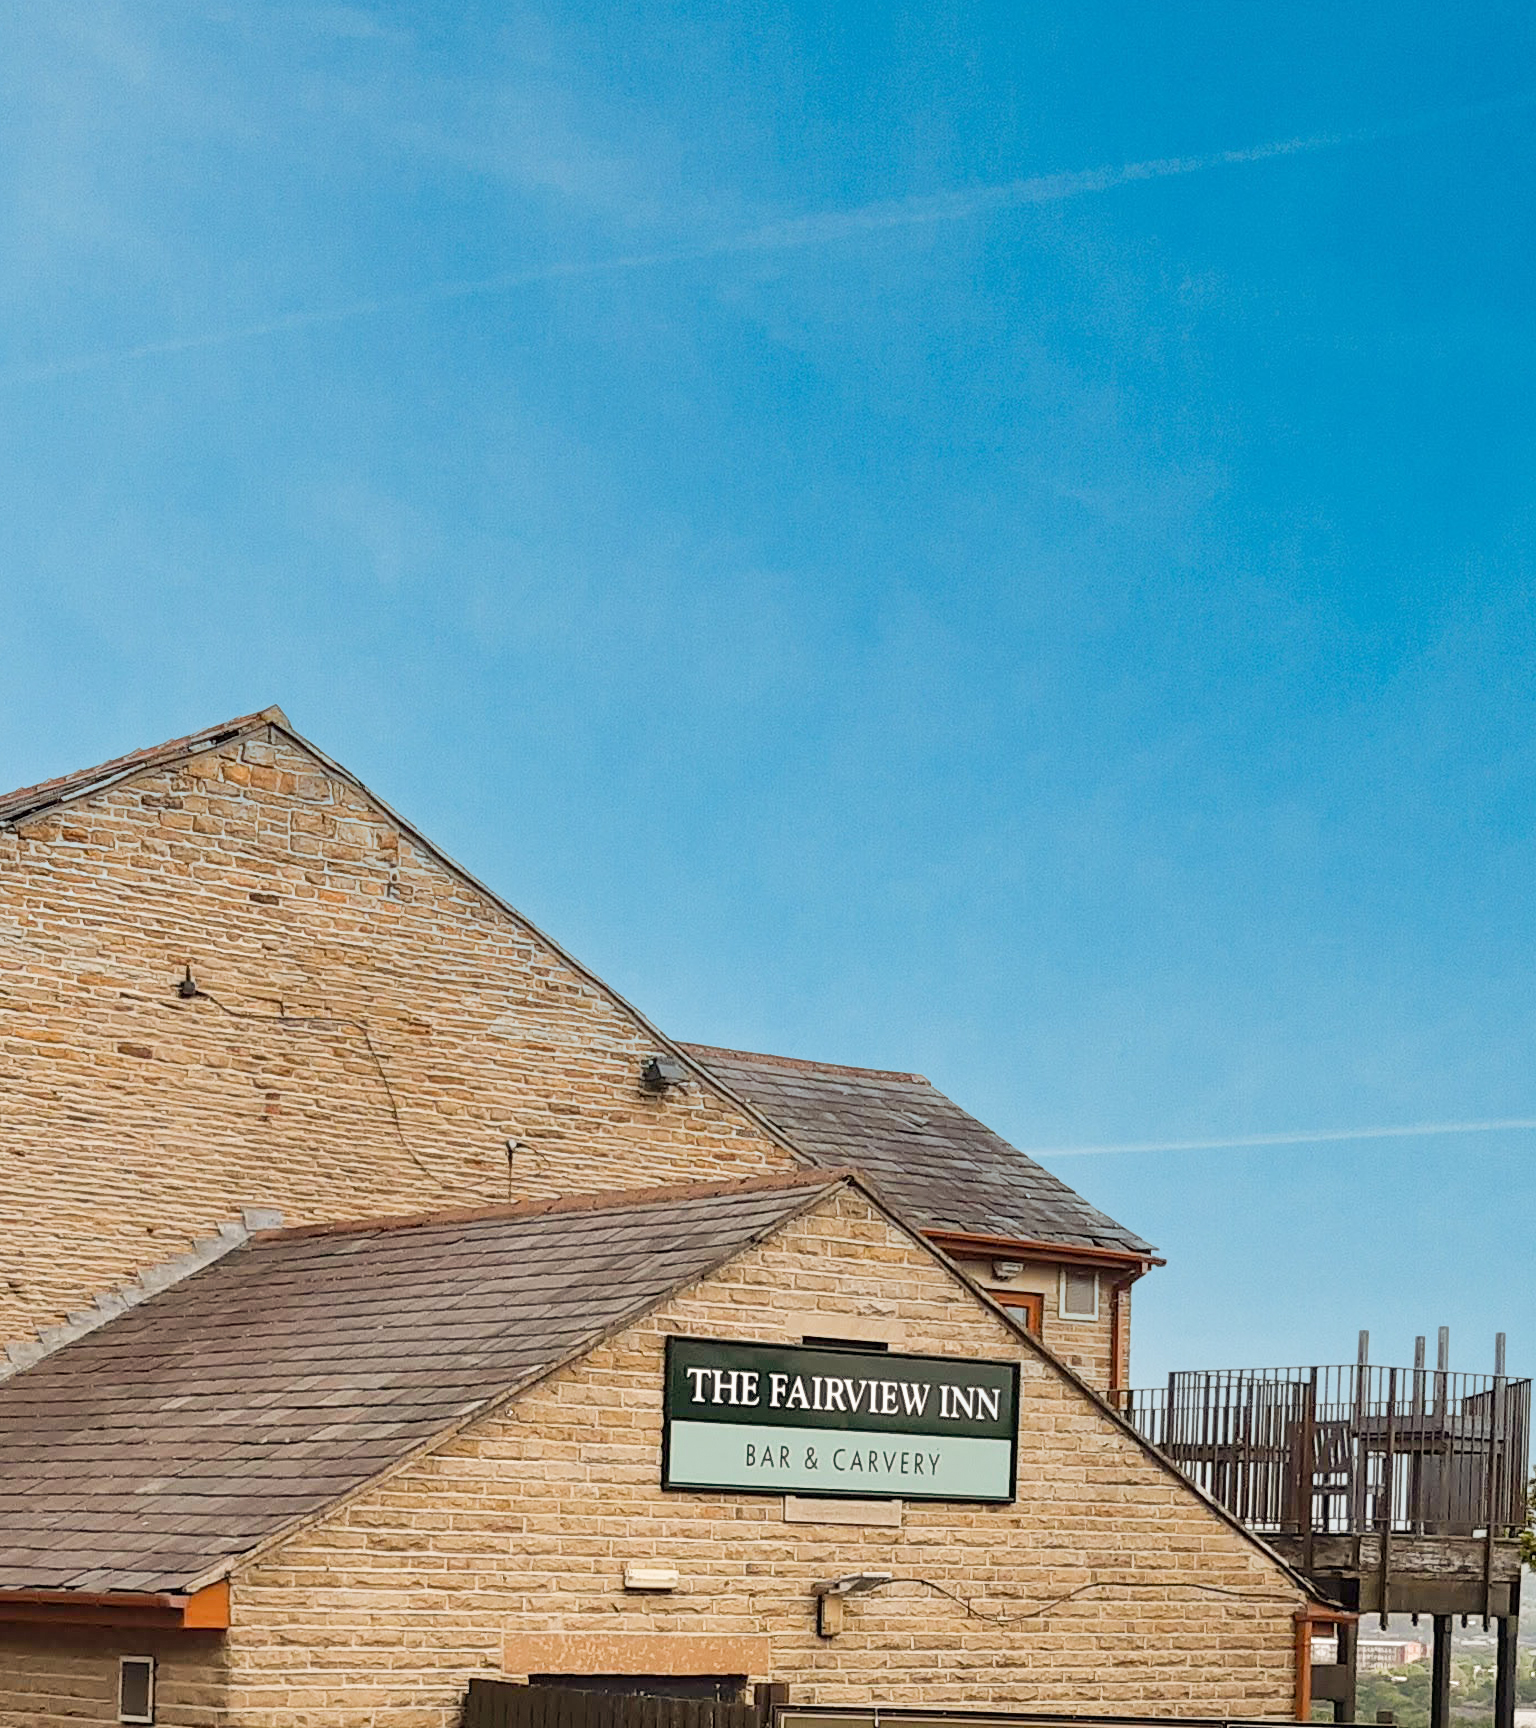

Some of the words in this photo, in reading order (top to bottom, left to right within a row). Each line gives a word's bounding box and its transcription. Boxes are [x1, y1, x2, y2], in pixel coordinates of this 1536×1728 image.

[687, 1367, 760, 1405] THE
[768, 1373, 931, 1416] FAIRVIEW
[939, 1385, 1001, 1420] INN
[746, 1444, 791, 1469] BAR
[804, 1448, 819, 1470] &
[833, 1448, 941, 1476] CARVERY
